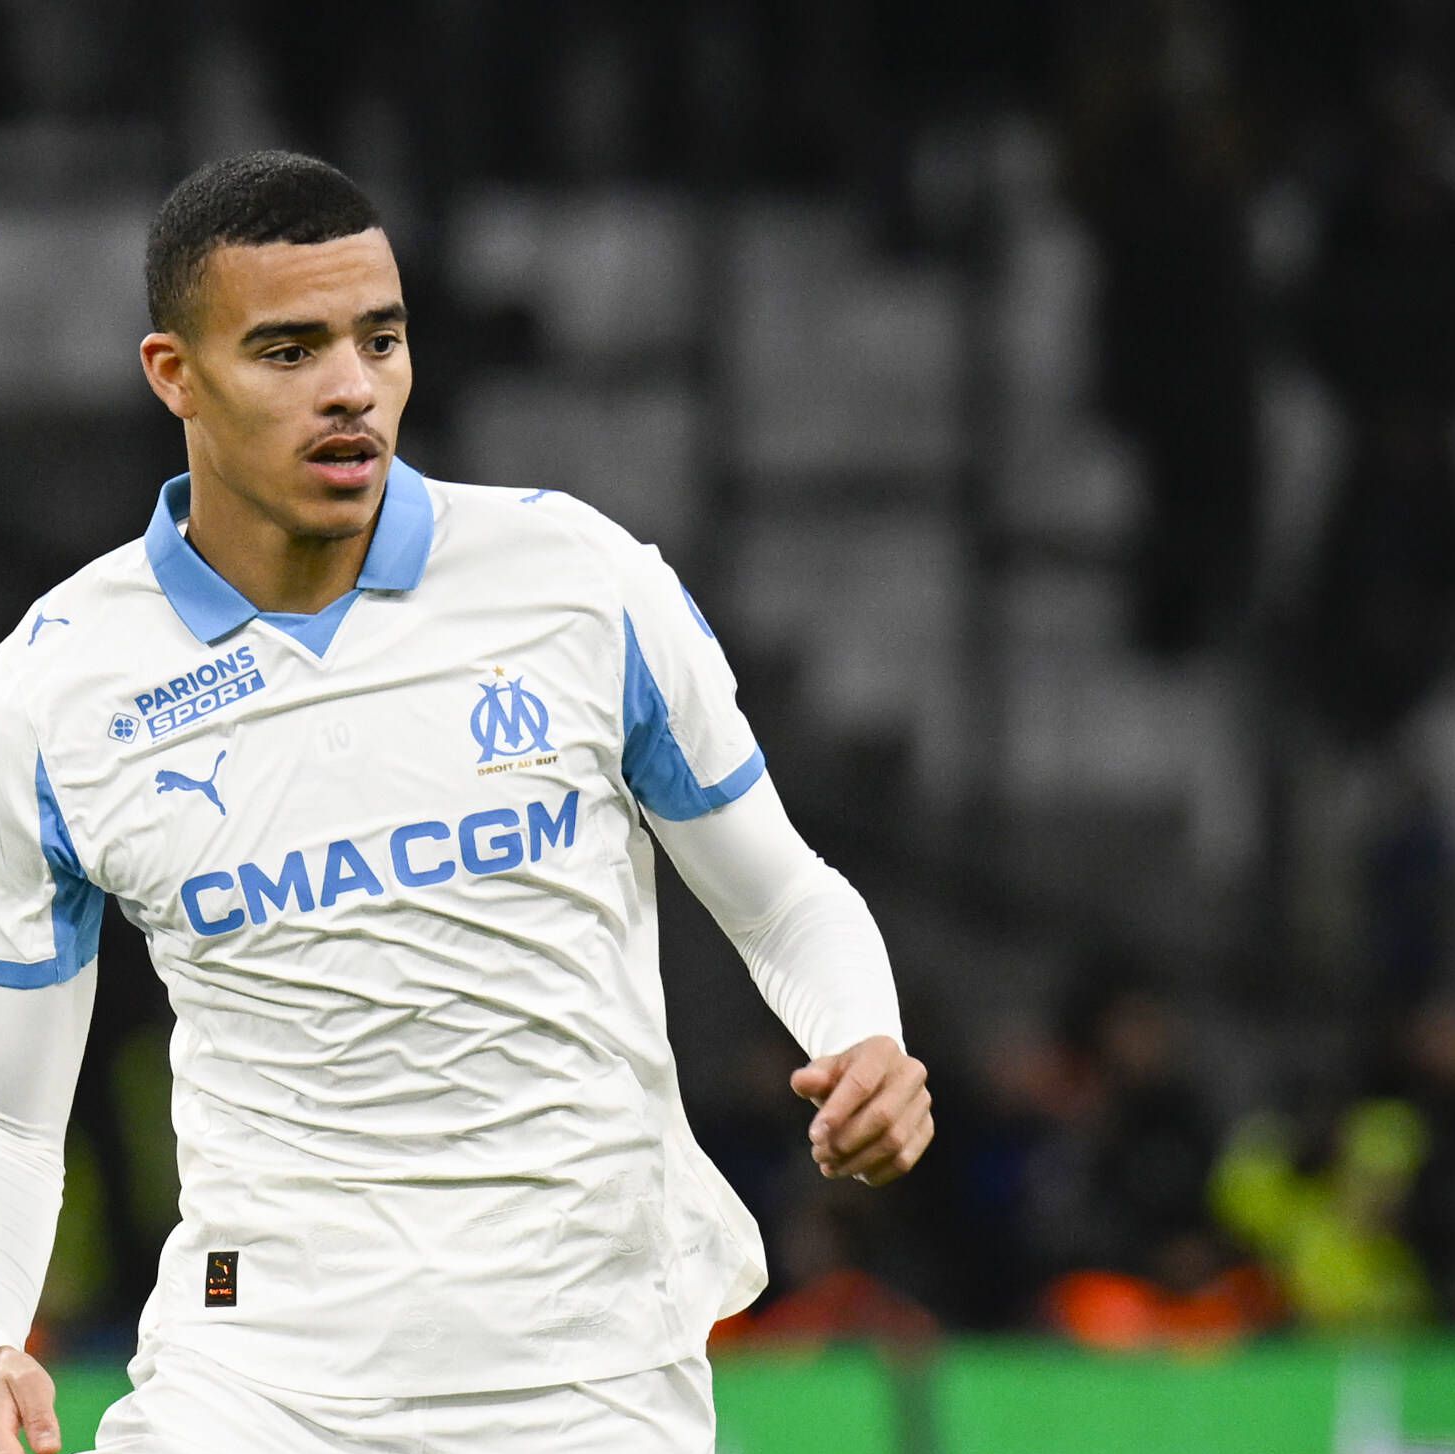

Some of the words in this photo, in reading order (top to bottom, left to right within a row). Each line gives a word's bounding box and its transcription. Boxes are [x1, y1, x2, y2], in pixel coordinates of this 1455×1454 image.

[134, 645, 255, 716] PARIONS
[151, 671, 259, 736] SPORT
[477, 763, 514, 776] DROIT
[517, 760, 532, 769] AU
[536, 755, 559, 766] BUT
[181, 850, 385, 937] CMA
[389, 790, 580, 888] CGM
